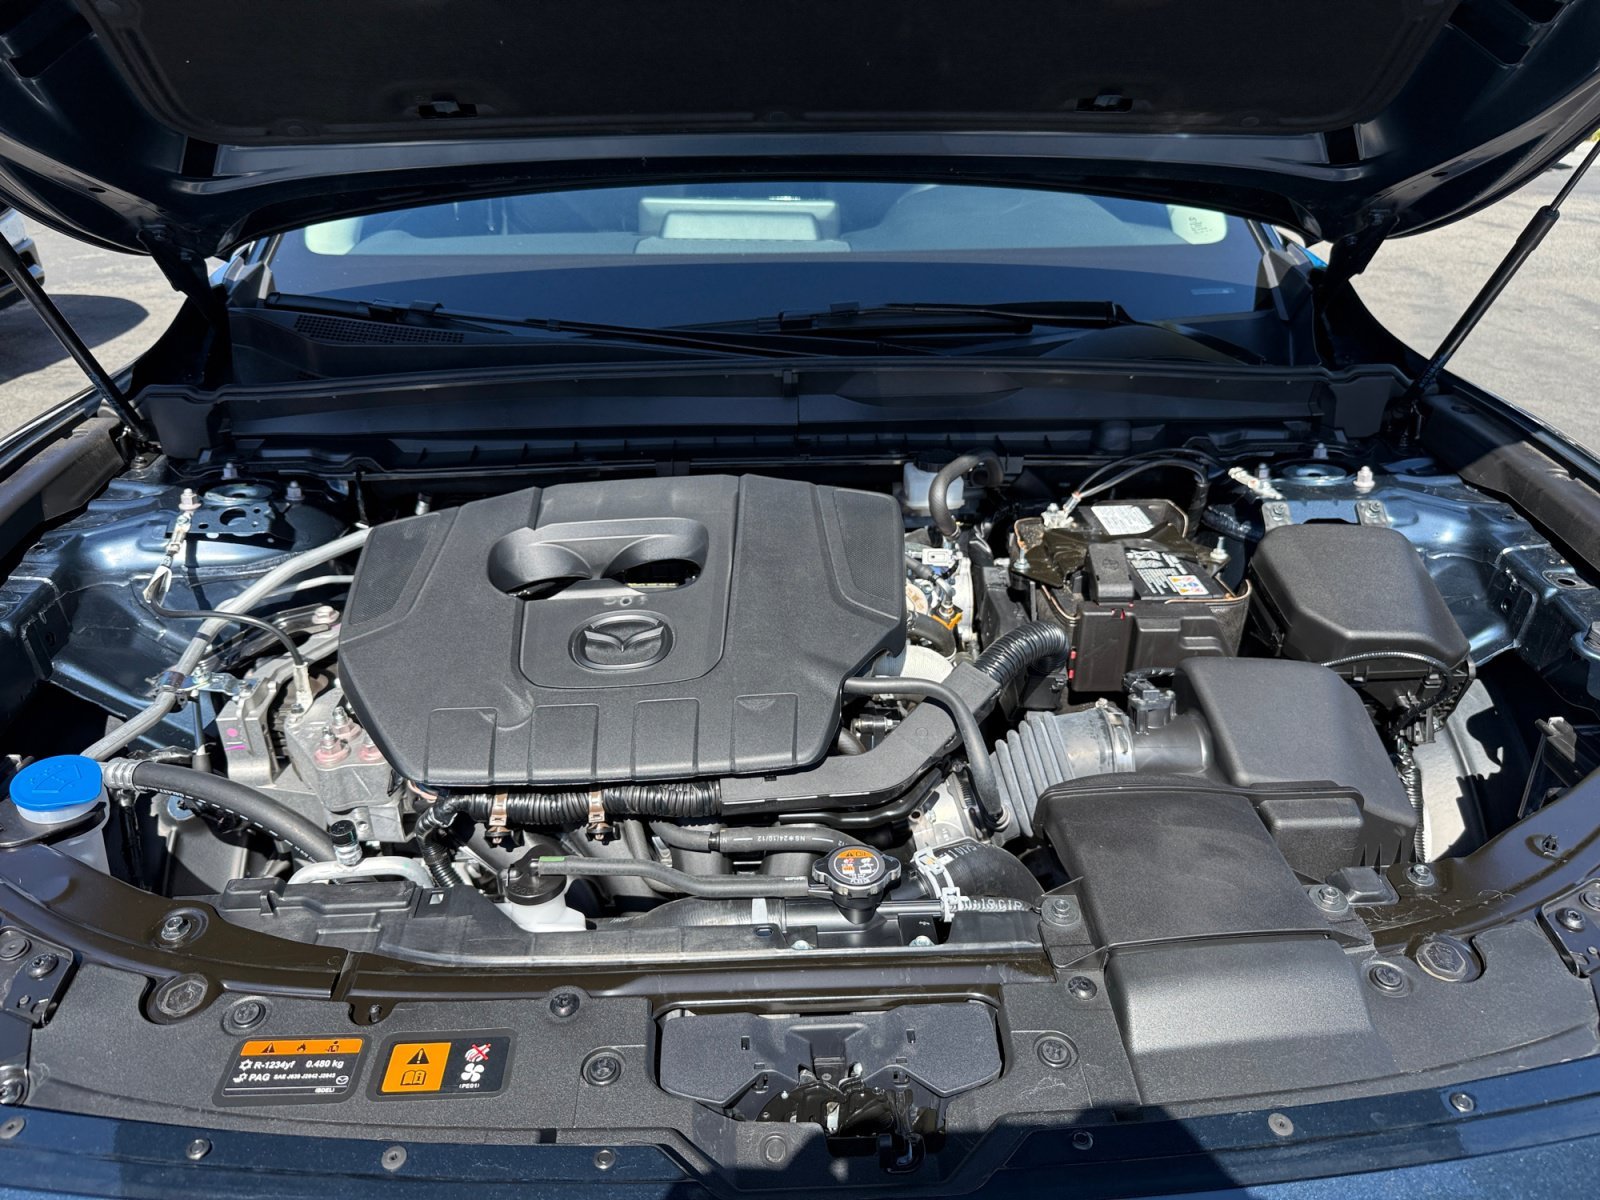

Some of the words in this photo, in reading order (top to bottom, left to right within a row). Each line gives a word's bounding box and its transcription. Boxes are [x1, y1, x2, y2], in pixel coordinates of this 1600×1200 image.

[253, 1060, 296, 1071] R-1234yf
[305, 1060, 331, 1069] 0.480
[332, 1059, 345, 1070] kg
[248, 1072, 271, 1082] PAG
